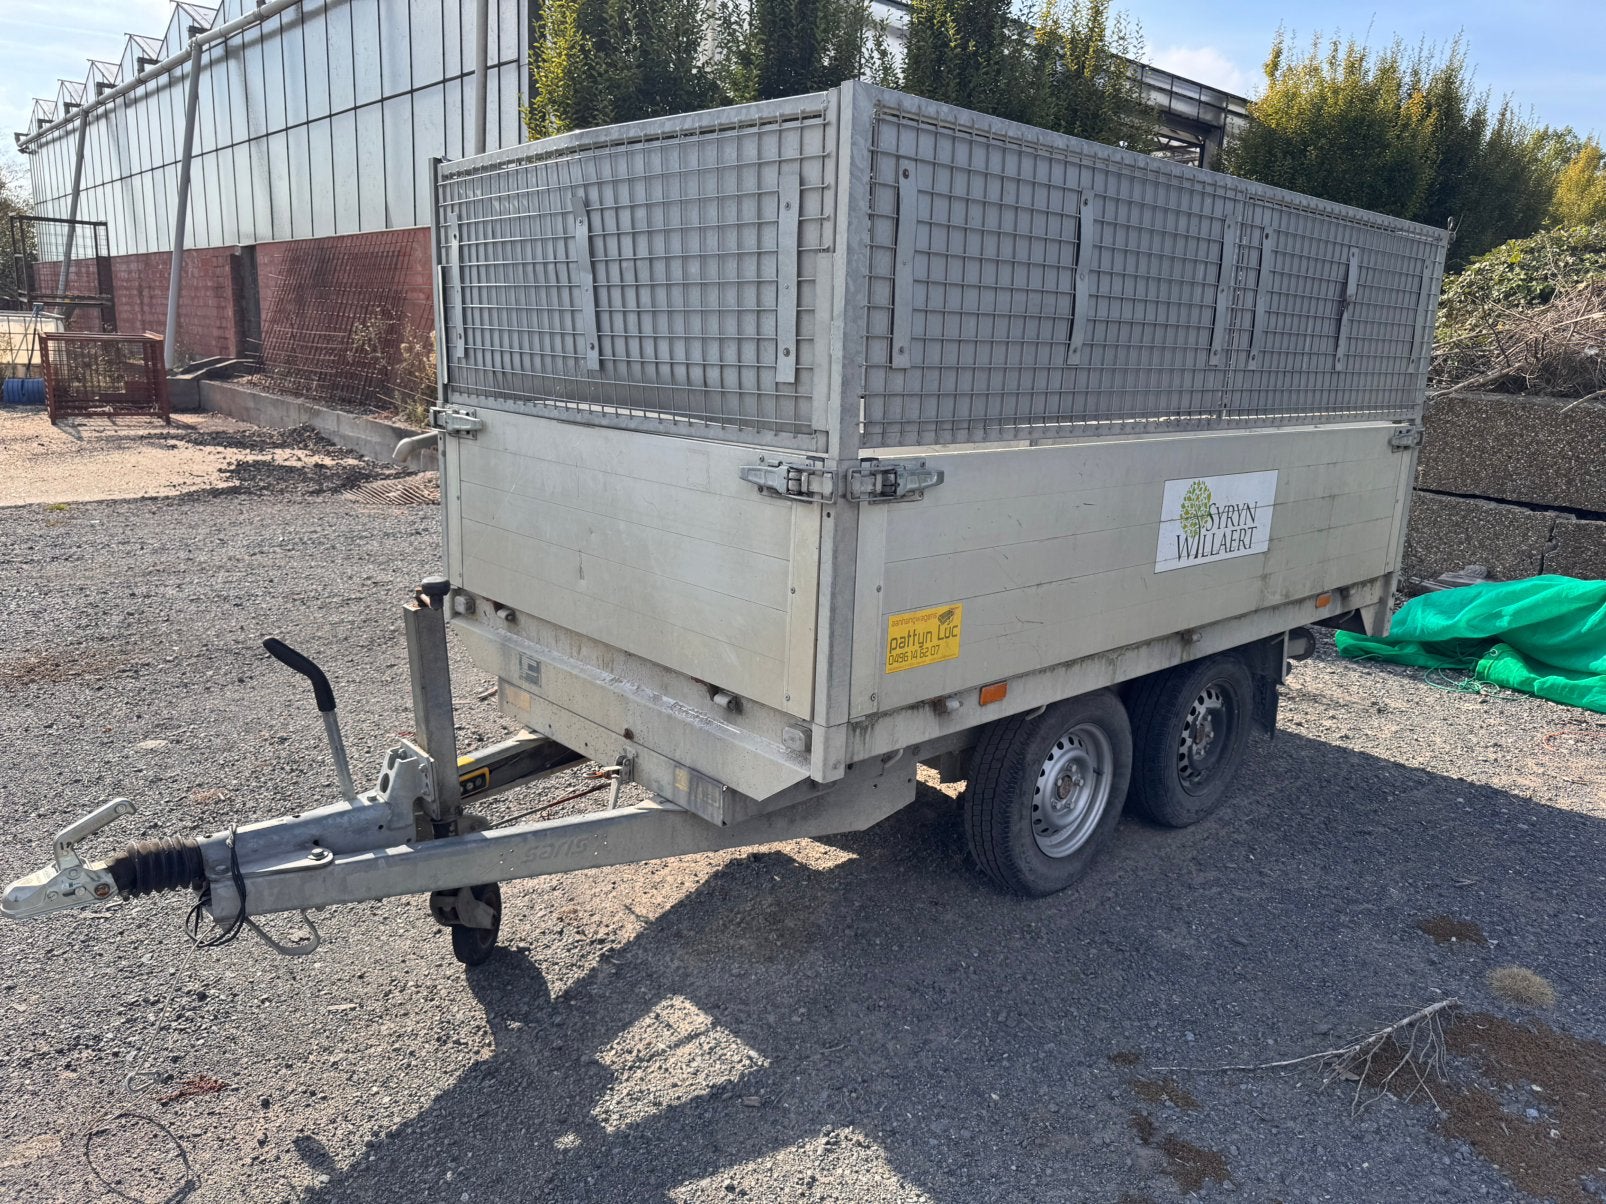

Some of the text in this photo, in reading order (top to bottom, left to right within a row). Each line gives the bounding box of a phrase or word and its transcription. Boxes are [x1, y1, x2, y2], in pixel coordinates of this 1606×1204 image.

[1206, 501, 1258, 532] SYRYN
[1176, 526, 1258, 562] WILLAERT
[888, 651, 909, 666] 0496
[910, 649, 918, 660] 14
[930, 645, 940, 656] 07
[889, 629, 933, 654] pattyn
[520, 836, 589, 864] saris
